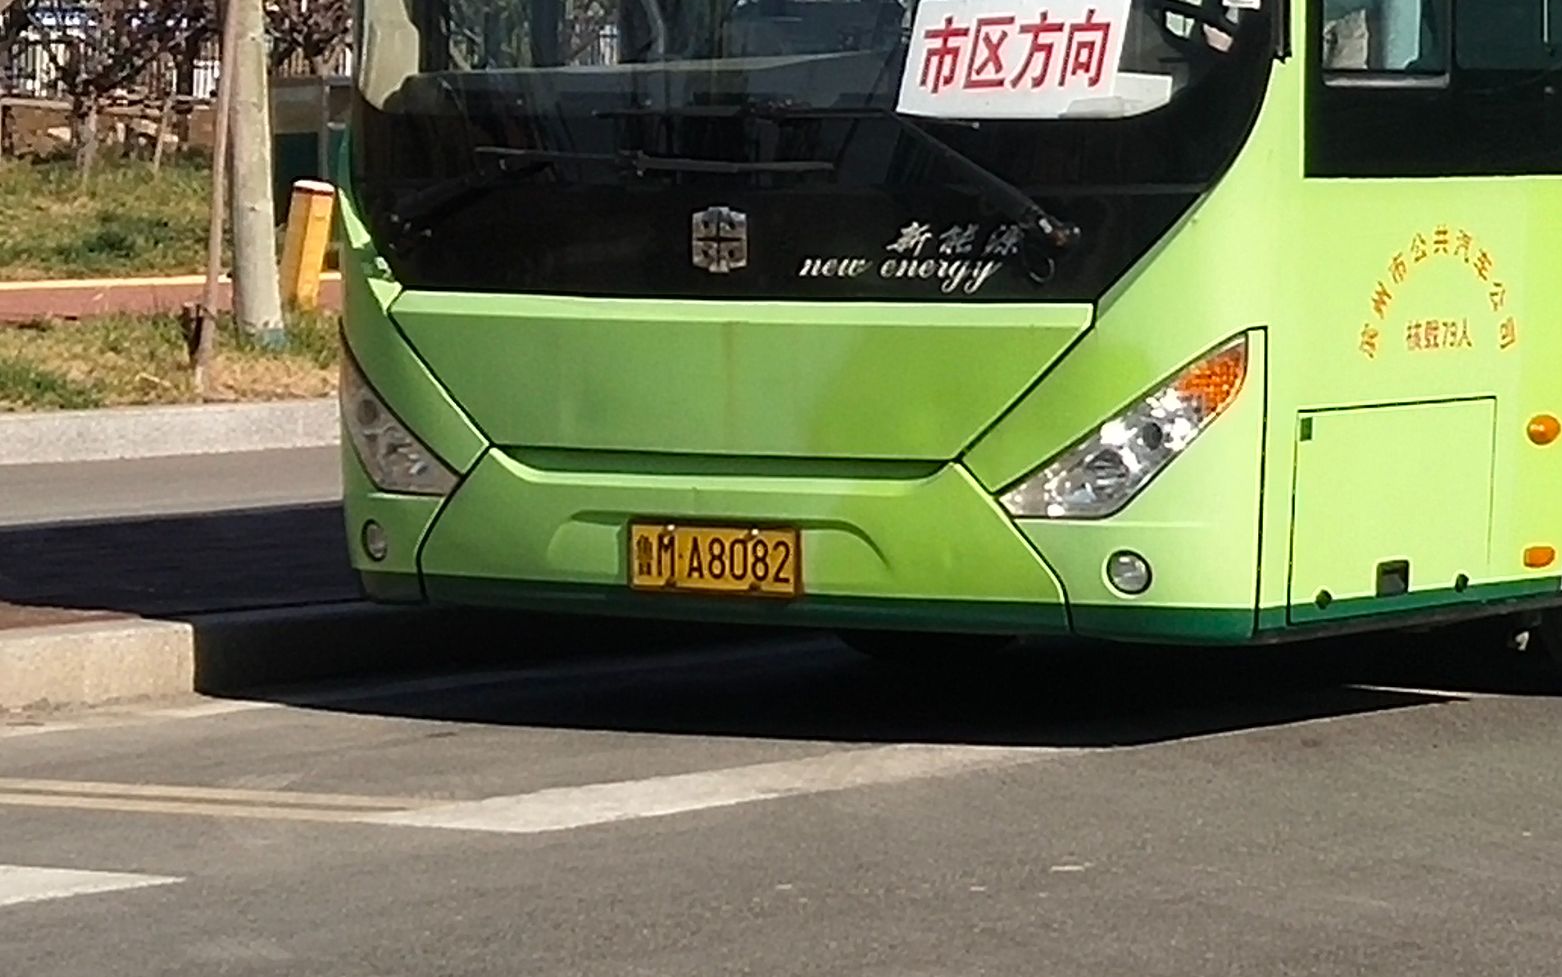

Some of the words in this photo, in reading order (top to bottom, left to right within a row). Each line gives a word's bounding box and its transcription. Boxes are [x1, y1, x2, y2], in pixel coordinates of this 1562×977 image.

[919, 9, 1113, 93] 市区方向
[886, 222, 1024, 256] 新能源
[799, 258, 872, 277] new
[880, 258, 1002, 294] energy
